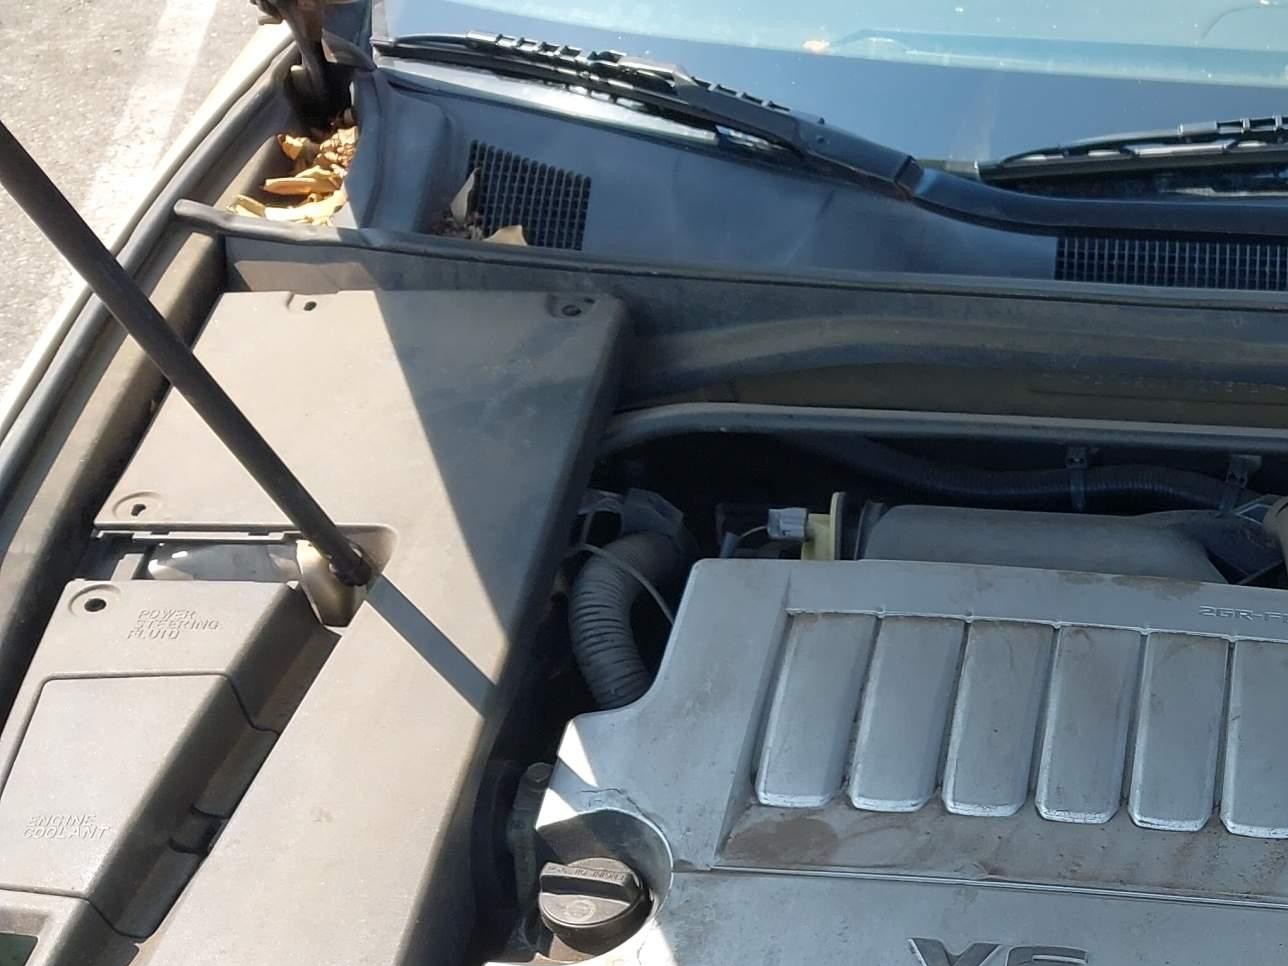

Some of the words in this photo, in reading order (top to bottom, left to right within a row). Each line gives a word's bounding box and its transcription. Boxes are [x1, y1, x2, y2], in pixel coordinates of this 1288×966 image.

[137, 608, 197, 620] POWER
[134, 618, 220, 631] STEERING
[127, 628, 181, 640] FLUID
[28, 813, 97, 827] ENGINE
[23, 825, 111, 840] COOLANT
